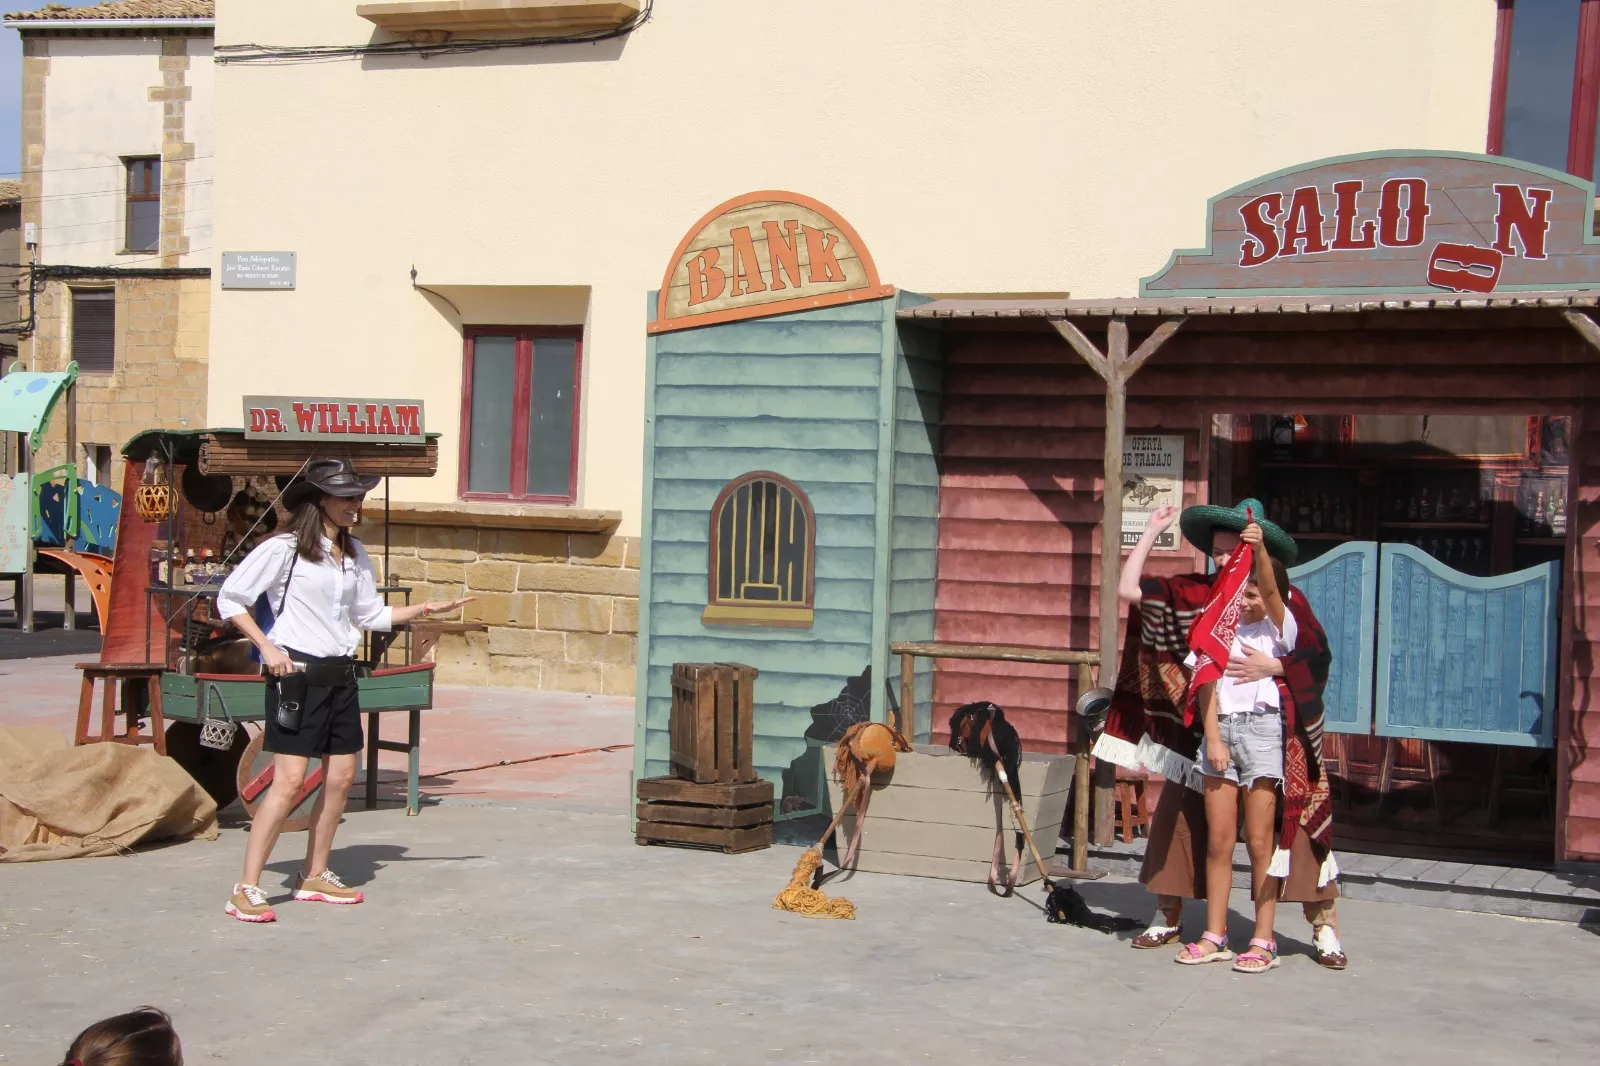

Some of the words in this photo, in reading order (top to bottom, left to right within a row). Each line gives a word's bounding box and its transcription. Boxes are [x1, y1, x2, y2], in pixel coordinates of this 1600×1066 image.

[686, 220, 847, 307] BANK
[249, 408, 288, 433] DR.
[292, 402, 421, 435] WILLIAM
[1132, 437, 1163, 451] OFERTA
[1134, 453, 1172, 467] TRABAJO
